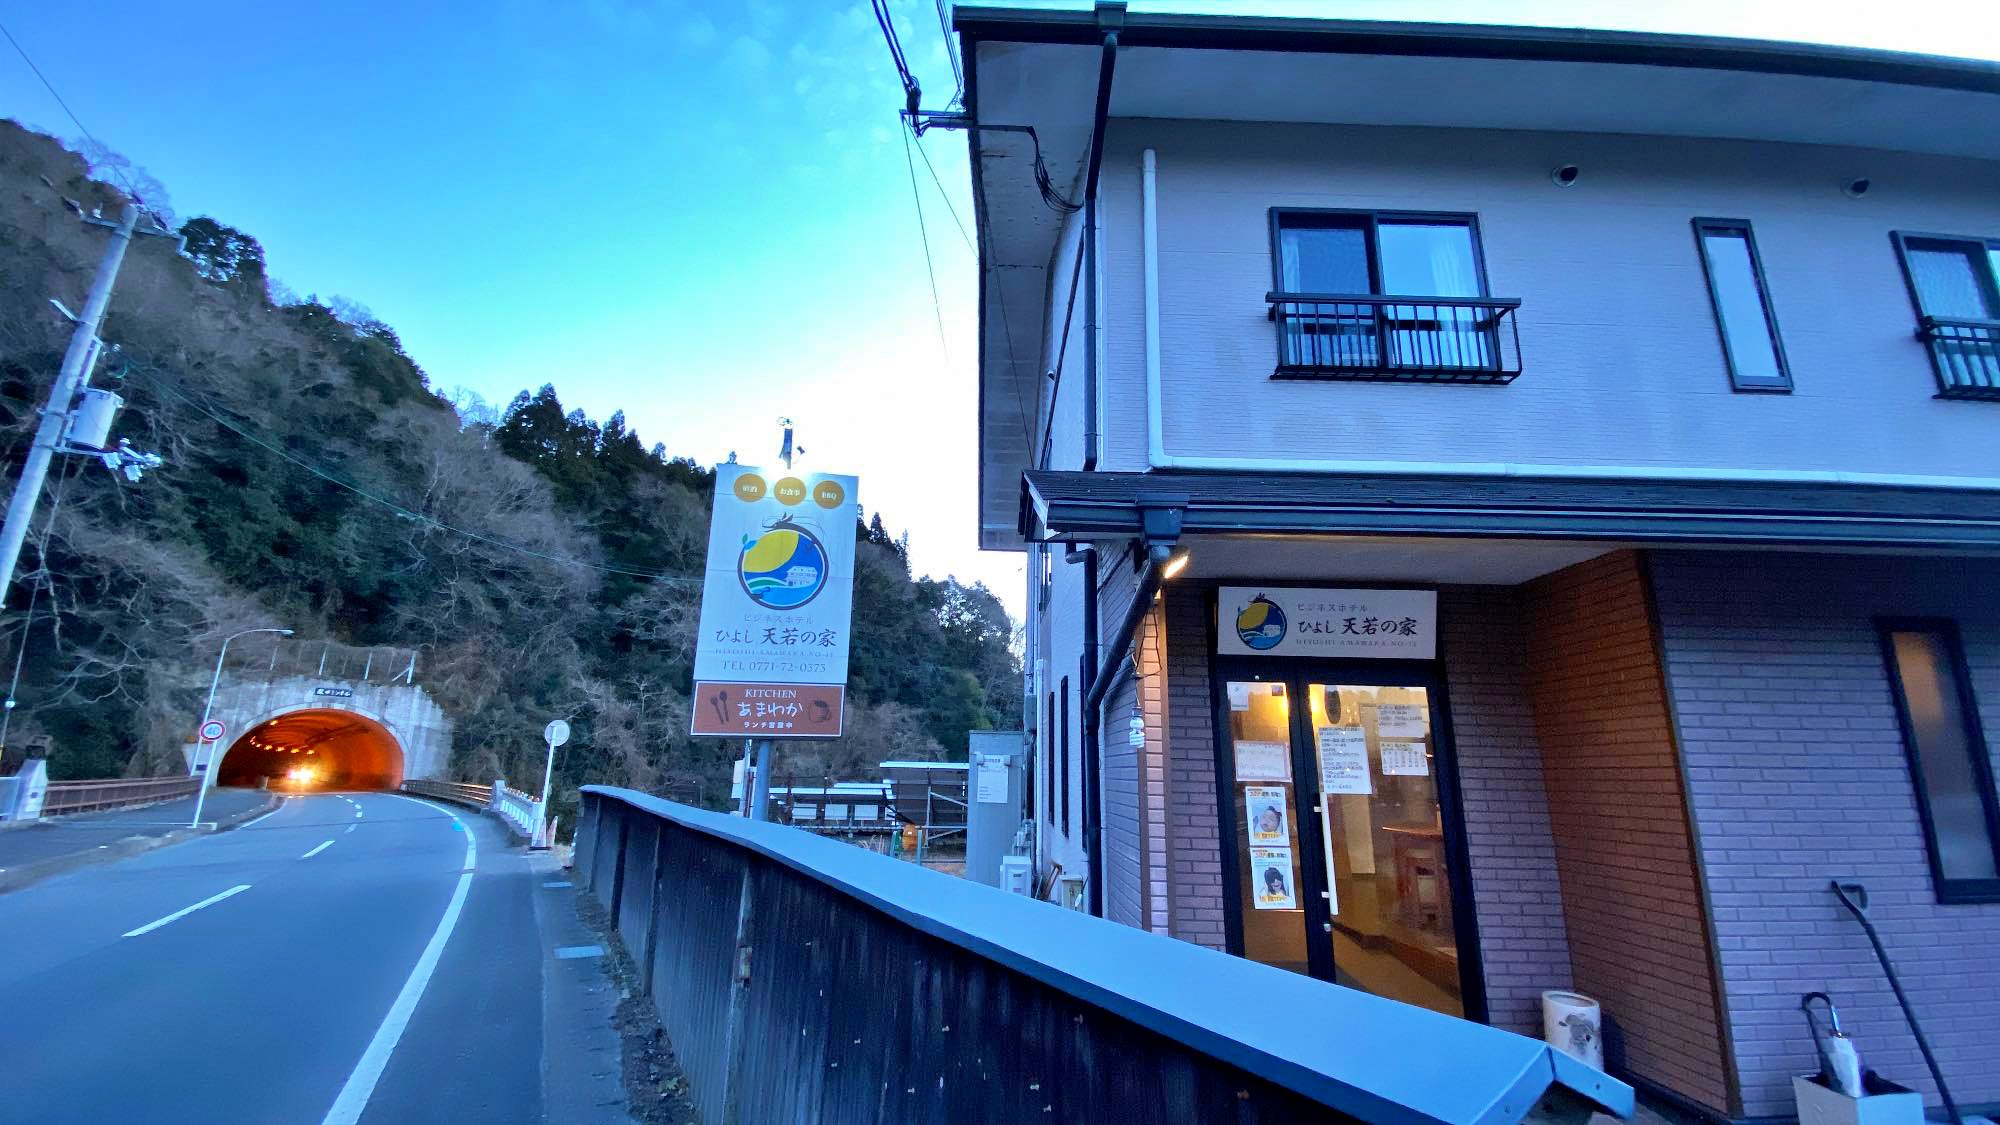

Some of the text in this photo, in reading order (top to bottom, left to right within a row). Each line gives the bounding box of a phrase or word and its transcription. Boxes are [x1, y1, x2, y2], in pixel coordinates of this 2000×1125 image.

[1297, 602, 1369, 613] ビジネスホテル
[744, 614, 814, 624] ビジネスホテル
[1298, 616, 1418, 636] ひよし 天若の家
[715, 627, 837, 648] ひよし 天若の家
[721, 660, 827, 673] TEL 0771-72-0373
[745, 688, 797, 699] KITCHEN
[737, 701, 804, 718] あまわか
[205, 726, 220, 735] 40
[743, 721, 793, 729] ランチ営業中
